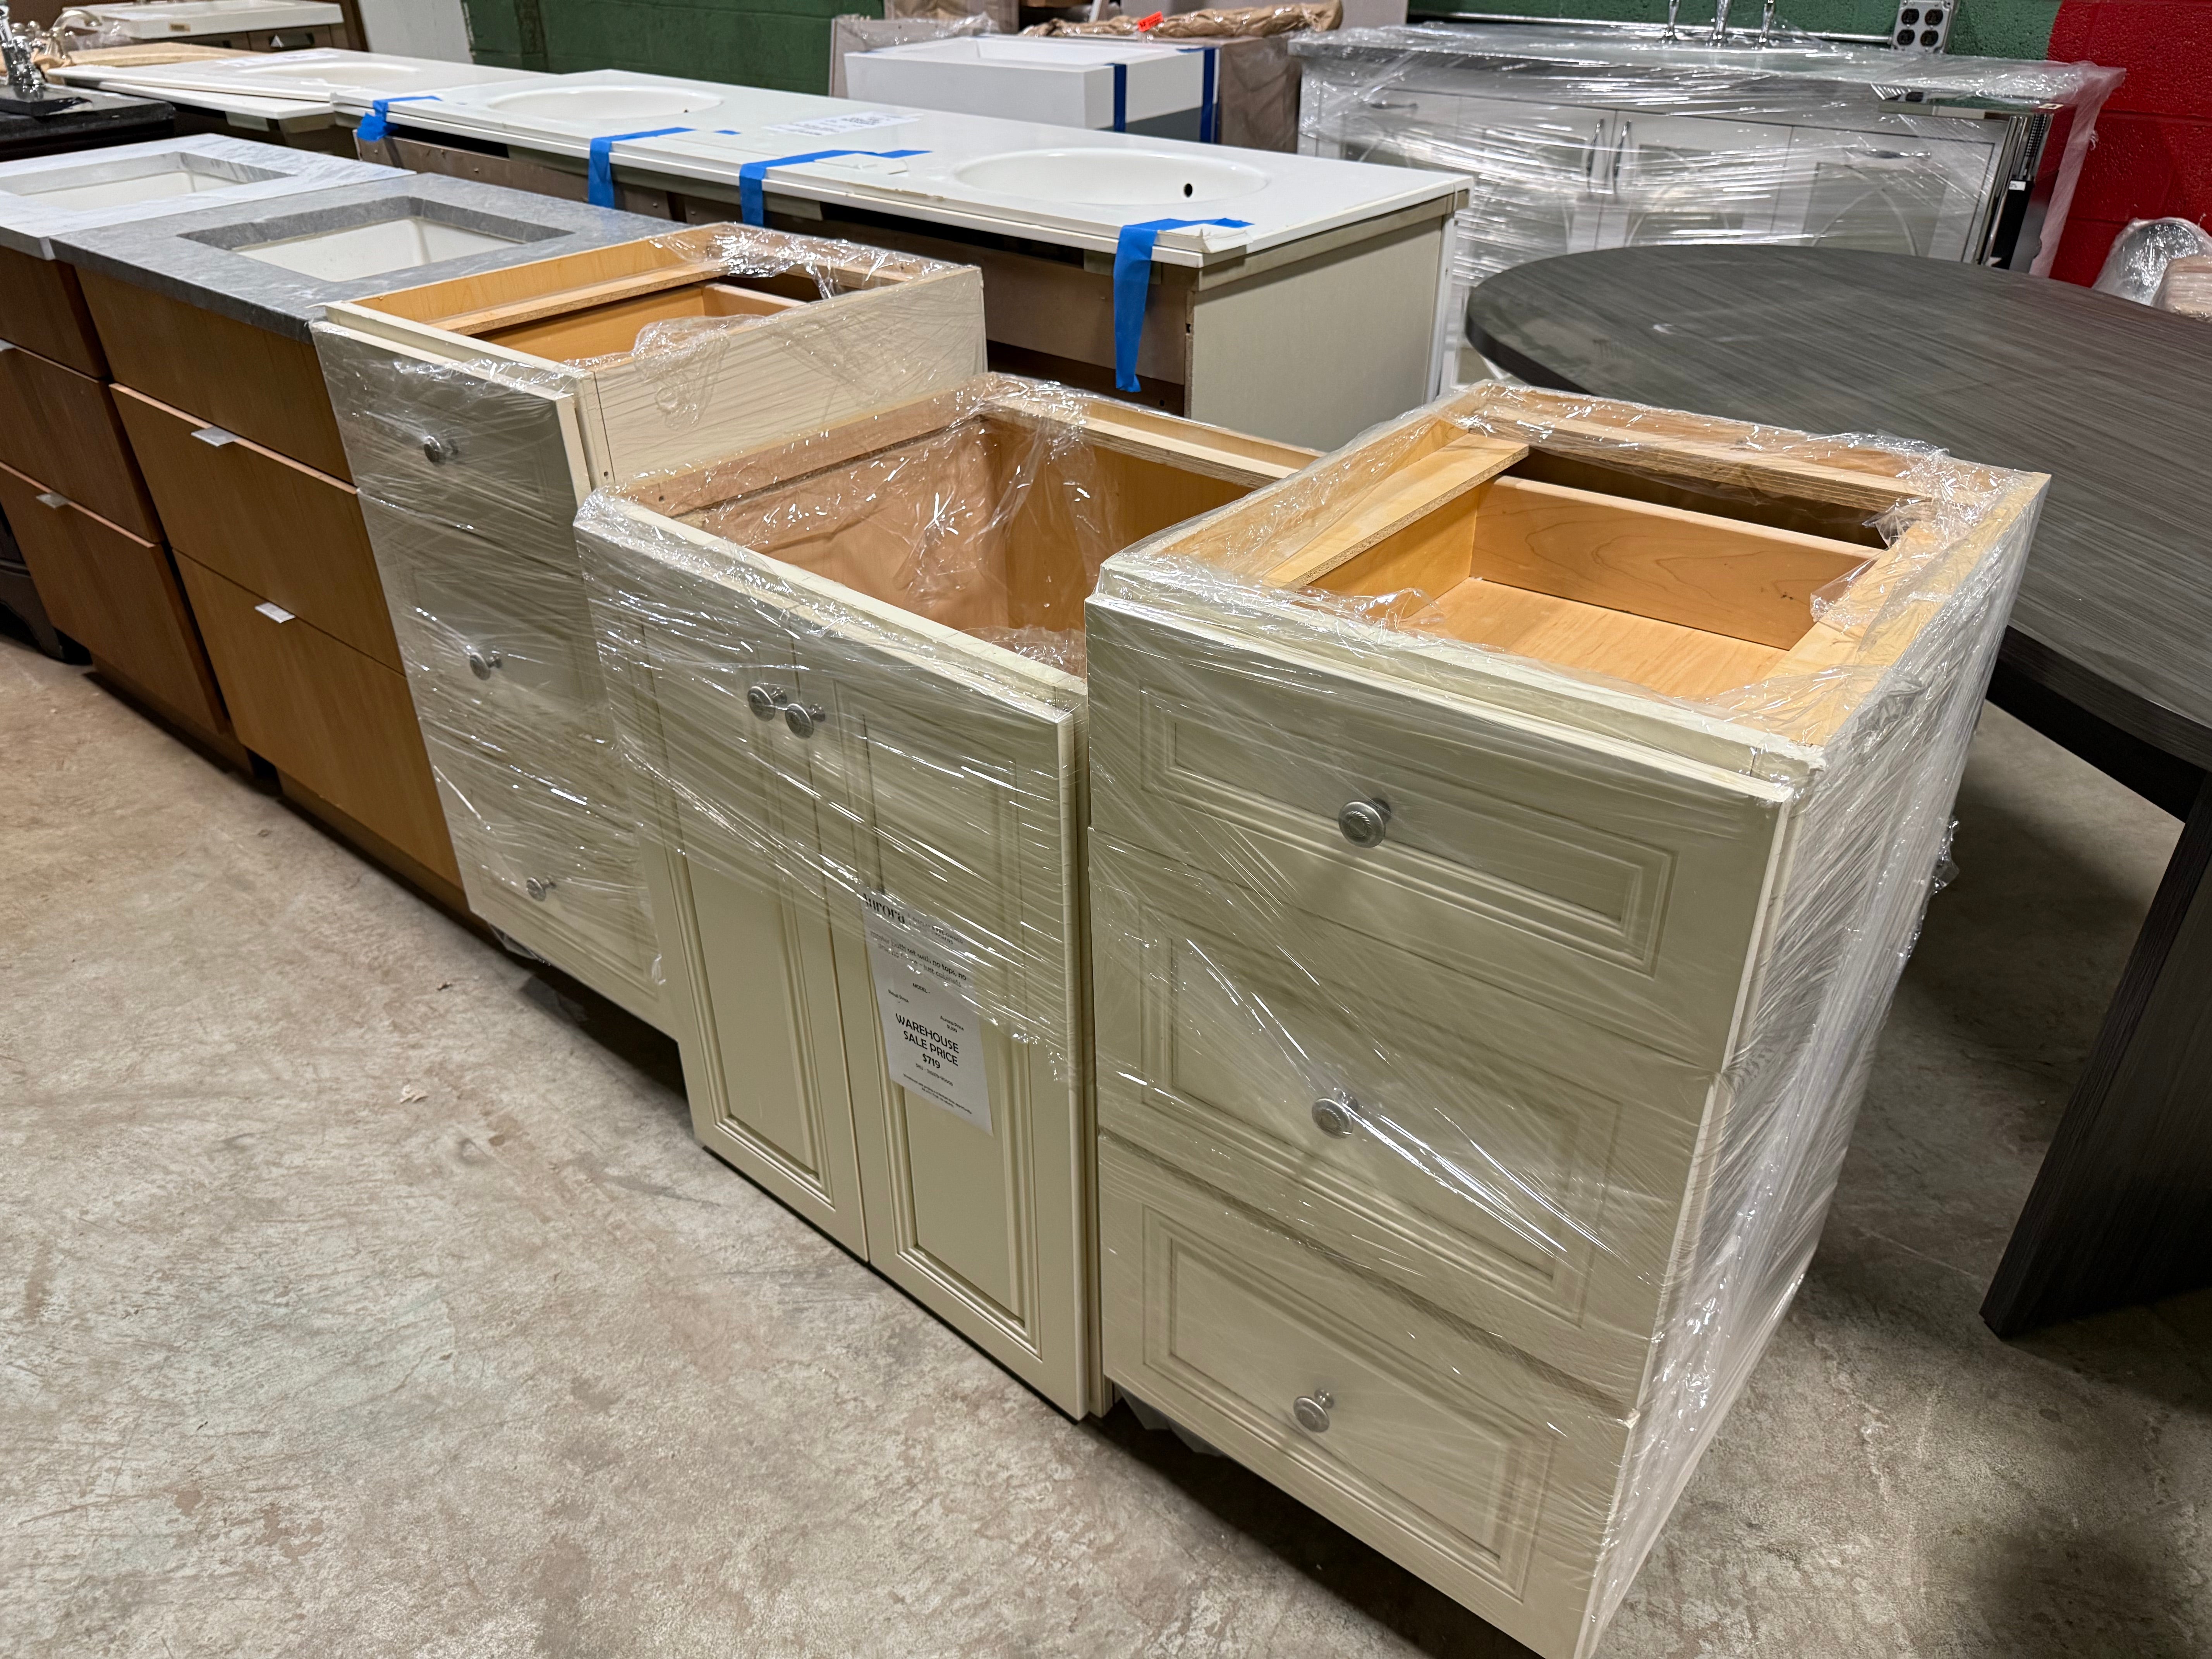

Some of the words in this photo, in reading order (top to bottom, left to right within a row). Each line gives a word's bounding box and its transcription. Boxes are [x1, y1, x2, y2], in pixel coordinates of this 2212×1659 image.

[958, 972, 967, 981] no
[896, 1013, 959, 1053] WAREHOUSE
[903, 1030, 928, 1050] SALE
[929, 1043, 958, 1066] PRICE
[922, 1053, 940, 1068] $719
